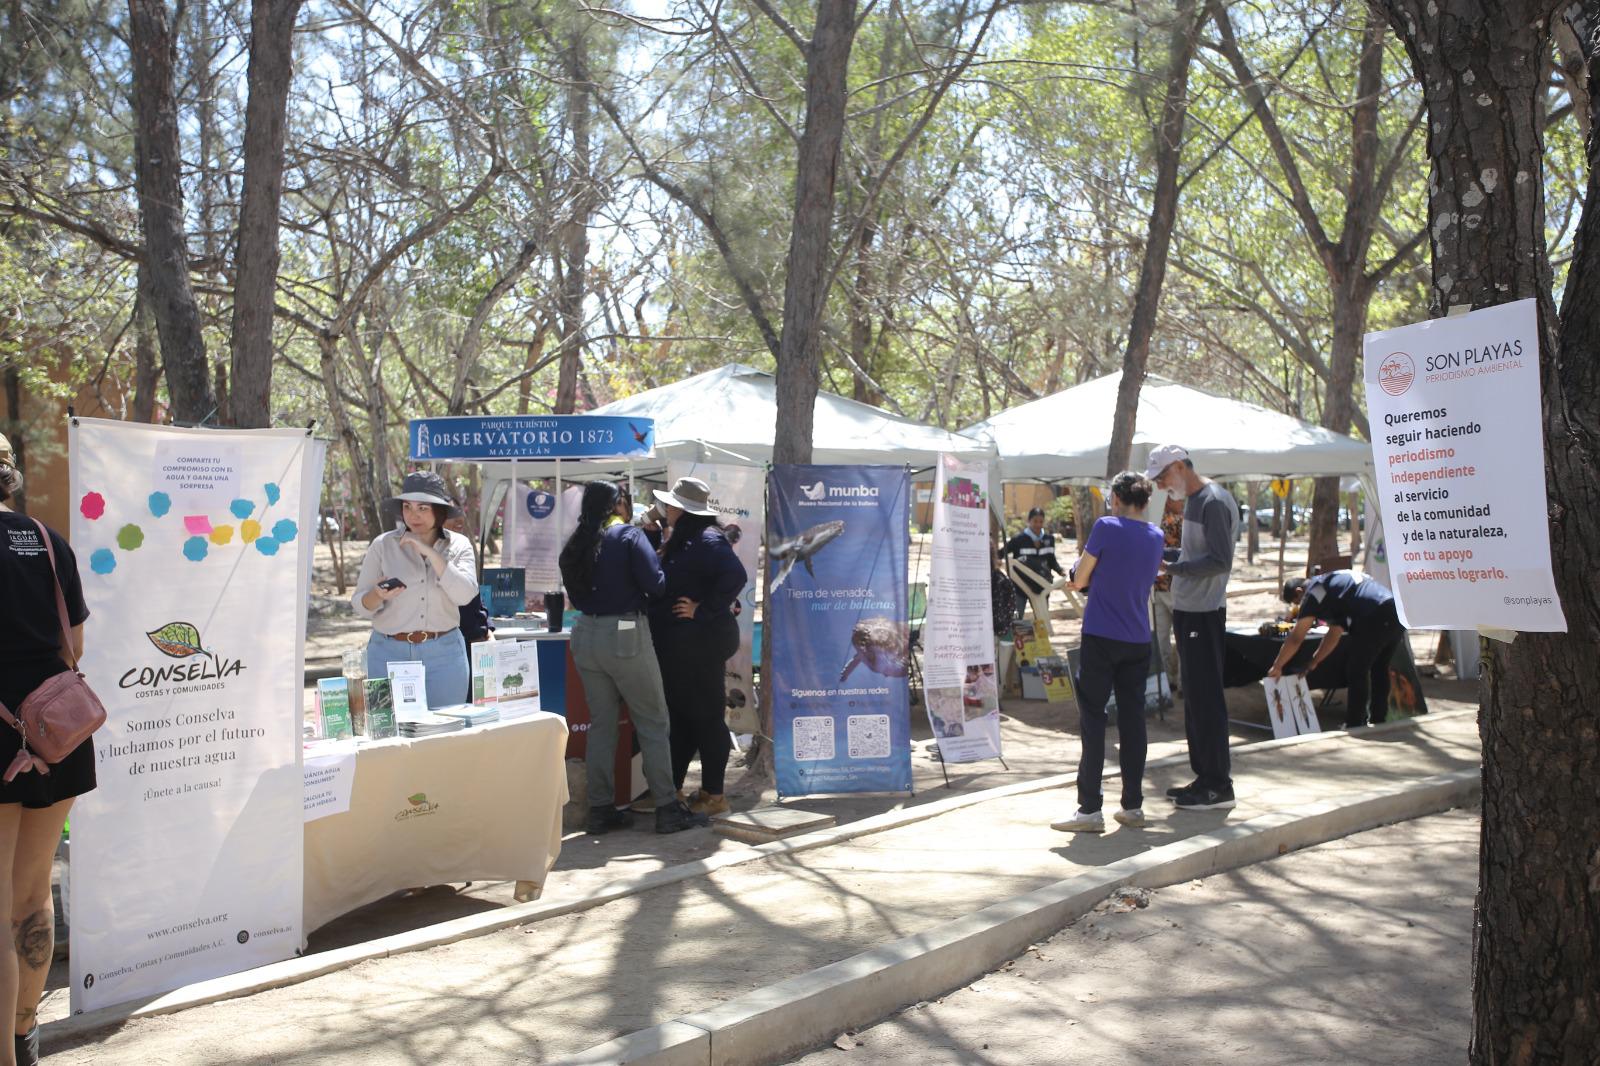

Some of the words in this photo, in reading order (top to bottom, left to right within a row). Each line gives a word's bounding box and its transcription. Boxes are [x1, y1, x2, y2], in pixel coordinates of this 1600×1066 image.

[1426, 352, 1460, 372] SON
[1465, 340, 1523, 365] PLAYAS
[1425, 368, 1476, 383] PERIODISMO
[1478, 360, 1523, 375] AMBIENTAL
[481, 421, 512, 430] PARQUE
[514, 419, 558, 429] TURÍSTICO
[1384, 408, 1447, 427] Queremos
[433, 430, 573, 447] OBSERVATORIO
[579, 429, 614, 444] 1873
[1386, 429, 1422, 446] seguir
[1425, 422, 1481, 440] haciendo
[489, 447, 551, 456] MAZATLÁN
[1388, 448, 1455, 467] periodismo
[1391, 465, 1476, 485] independiente
[829, 485, 879, 497] munba
[1394, 491, 1403, 503] al
[1406, 487, 1449, 502] servicio
[1397, 510, 1410, 522] de
[1411, 509, 1421, 521] la
[1424, 504, 1491, 521] comunidad
[1403, 531, 1409, 544] y
[1411, 529, 1424, 541] de
[1426, 528, 1436, 540] la
[1439, 525, 1507, 540] naturaleza,
[1403, 551, 1421, 561] con
[1423, 550, 1435, 561] tu
[1438, 549, 1473, 563] apoyo
[1406, 569, 1455, 583] podemos
[1458, 566, 1508, 582] lograrlo.
[787, 588, 814, 599] Tierra
[815, 588, 828, 598] de
[830, 587, 875, 598] venados,
[1503, 594, 1552, 607] @sonplayas
[811, 602, 831, 611] mar
[834, 600, 847, 610] de
[849, 599, 896, 611] ballenas
[118, 654, 247, 689] CONSELVA
[135, 688, 164, 699] COSTAS
[165, 688, 170, 696] Y
[172, 682, 225, 695] COMUNIDADES
[838, 688, 867, 696] nuestras
[868, 686, 889, 695] redes
[126, 717, 171, 733] Somos
[175, 708, 235, 727] Conselva
[99, 748, 110, 763] y
[110, 739, 174, 758] luchamos
[178, 733, 201, 750] por
[205, 729, 216, 743] el
[221, 726, 265, 741] futuro
[129, 761, 145, 776] de
[150, 755, 200, 773] nuestra
[204, 749, 236, 765] agua
[143, 786, 174, 801] ¡Únete
[176, 786, 182, 794] a
[184, 783, 192, 793] la
[194, 777, 222, 791] causa!
[147, 911, 229, 940] www.conselva.org
[99, 966, 135, 982] Conselva,
[135, 957, 158, 971] Costas
[164, 943, 211, 961] Comunidades
